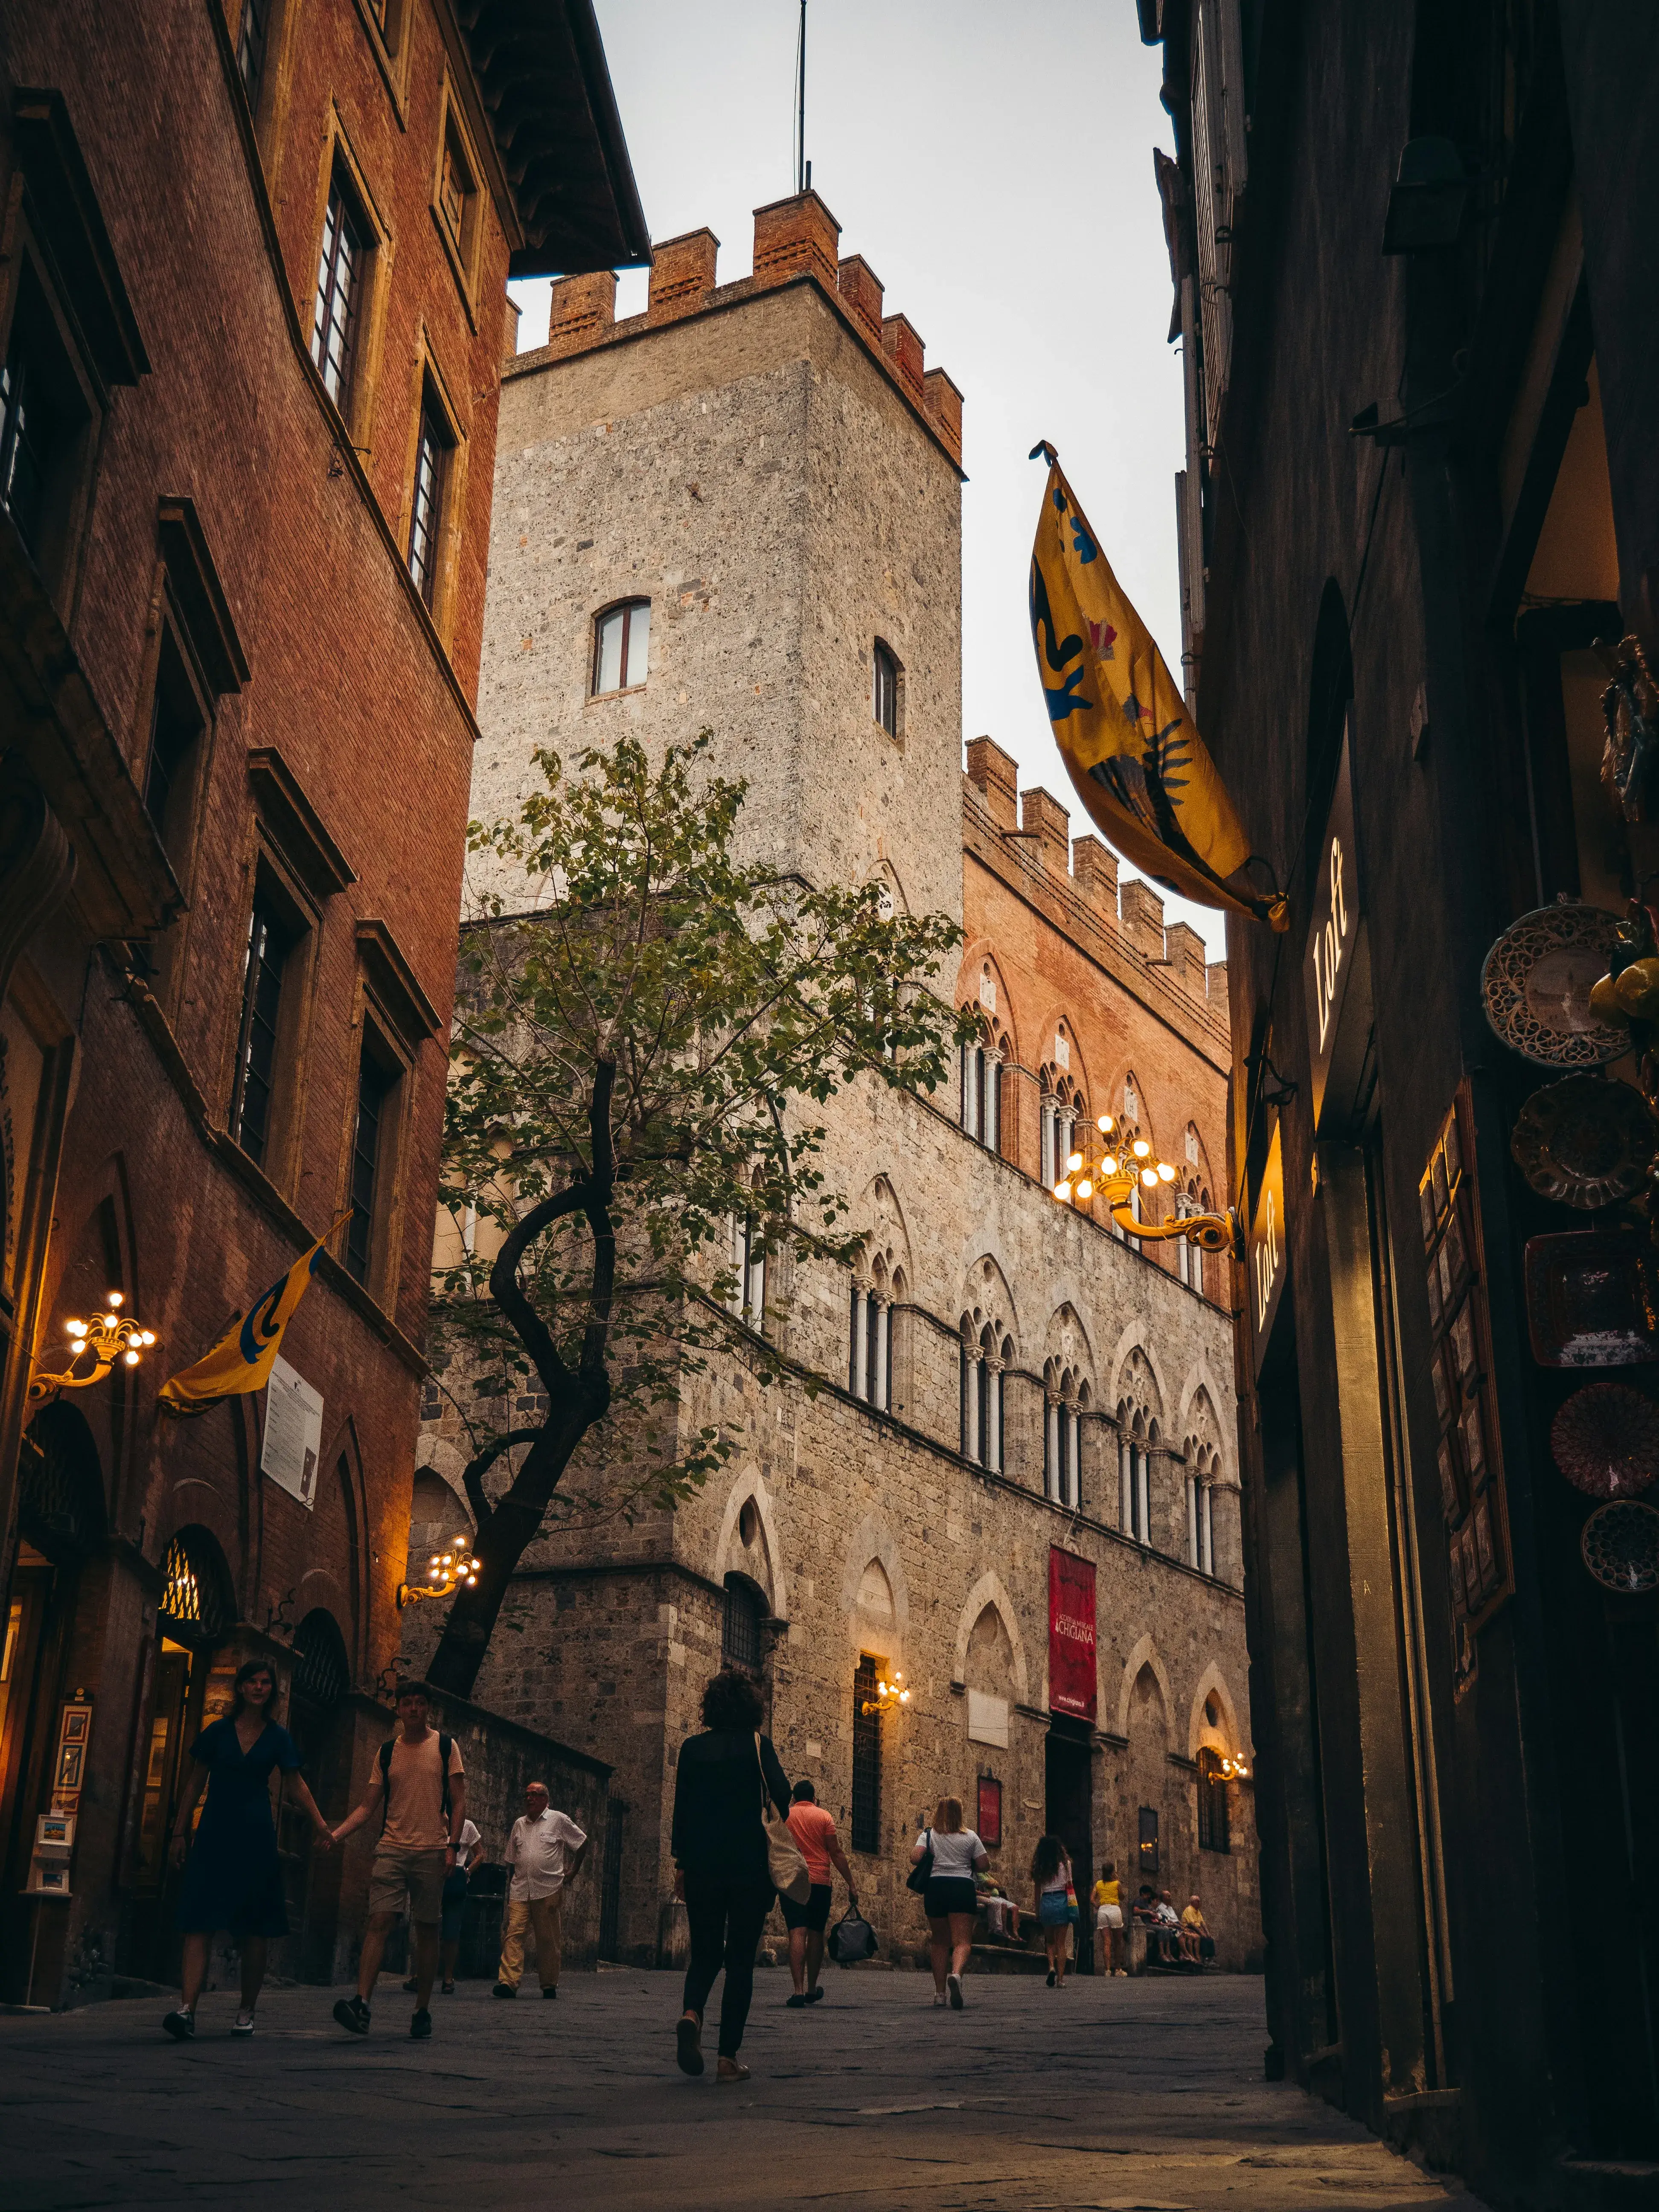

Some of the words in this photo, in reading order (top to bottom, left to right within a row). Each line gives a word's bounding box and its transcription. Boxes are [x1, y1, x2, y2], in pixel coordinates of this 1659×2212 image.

[1313, 837, 1347, 1054] Loft
[1255, 1189, 1278, 1333] Loft
[1059, 1621, 1093, 1644] CHIGIANA
